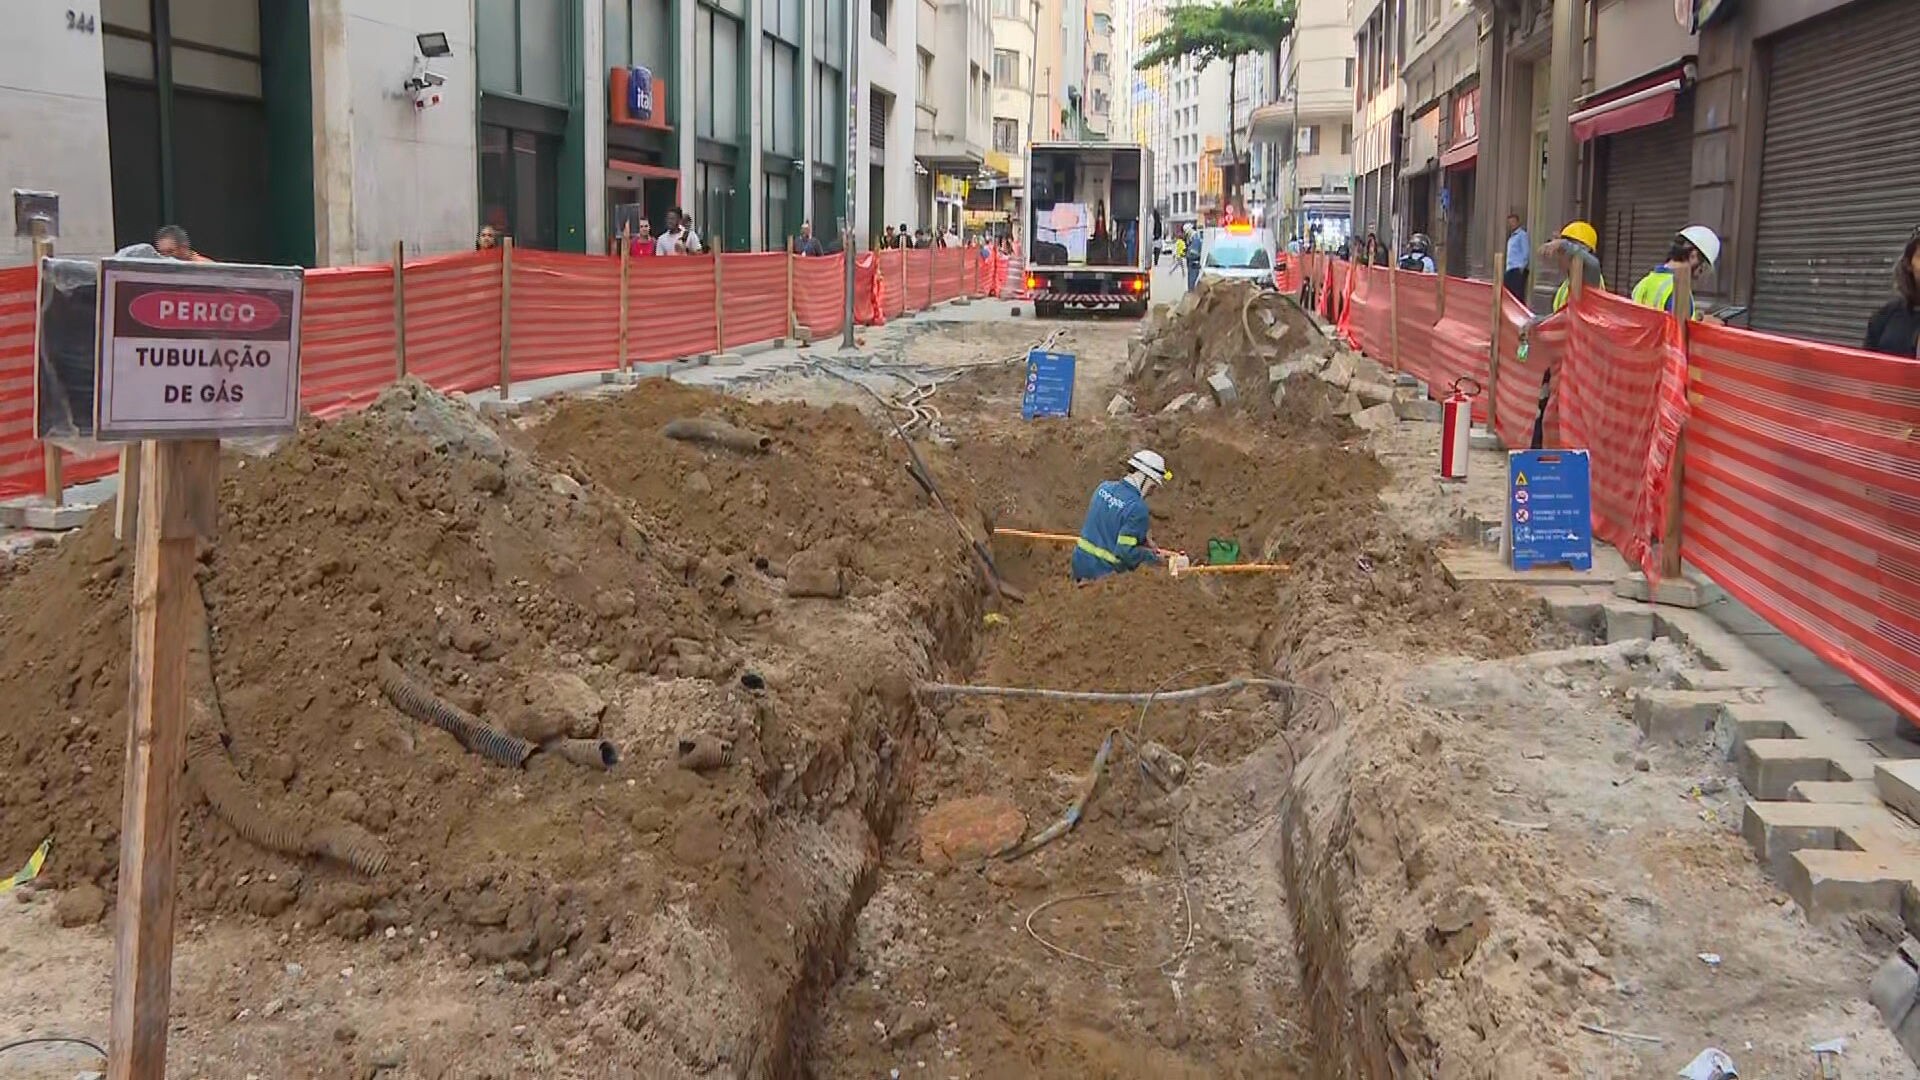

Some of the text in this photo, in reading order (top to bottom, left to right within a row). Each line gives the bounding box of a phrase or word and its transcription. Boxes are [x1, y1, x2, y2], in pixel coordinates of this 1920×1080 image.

[159, 300, 256, 322] PERIGO
[136, 345, 271, 372] TUBULAÇÃO
[164, 380, 244, 403] DE GÁS
